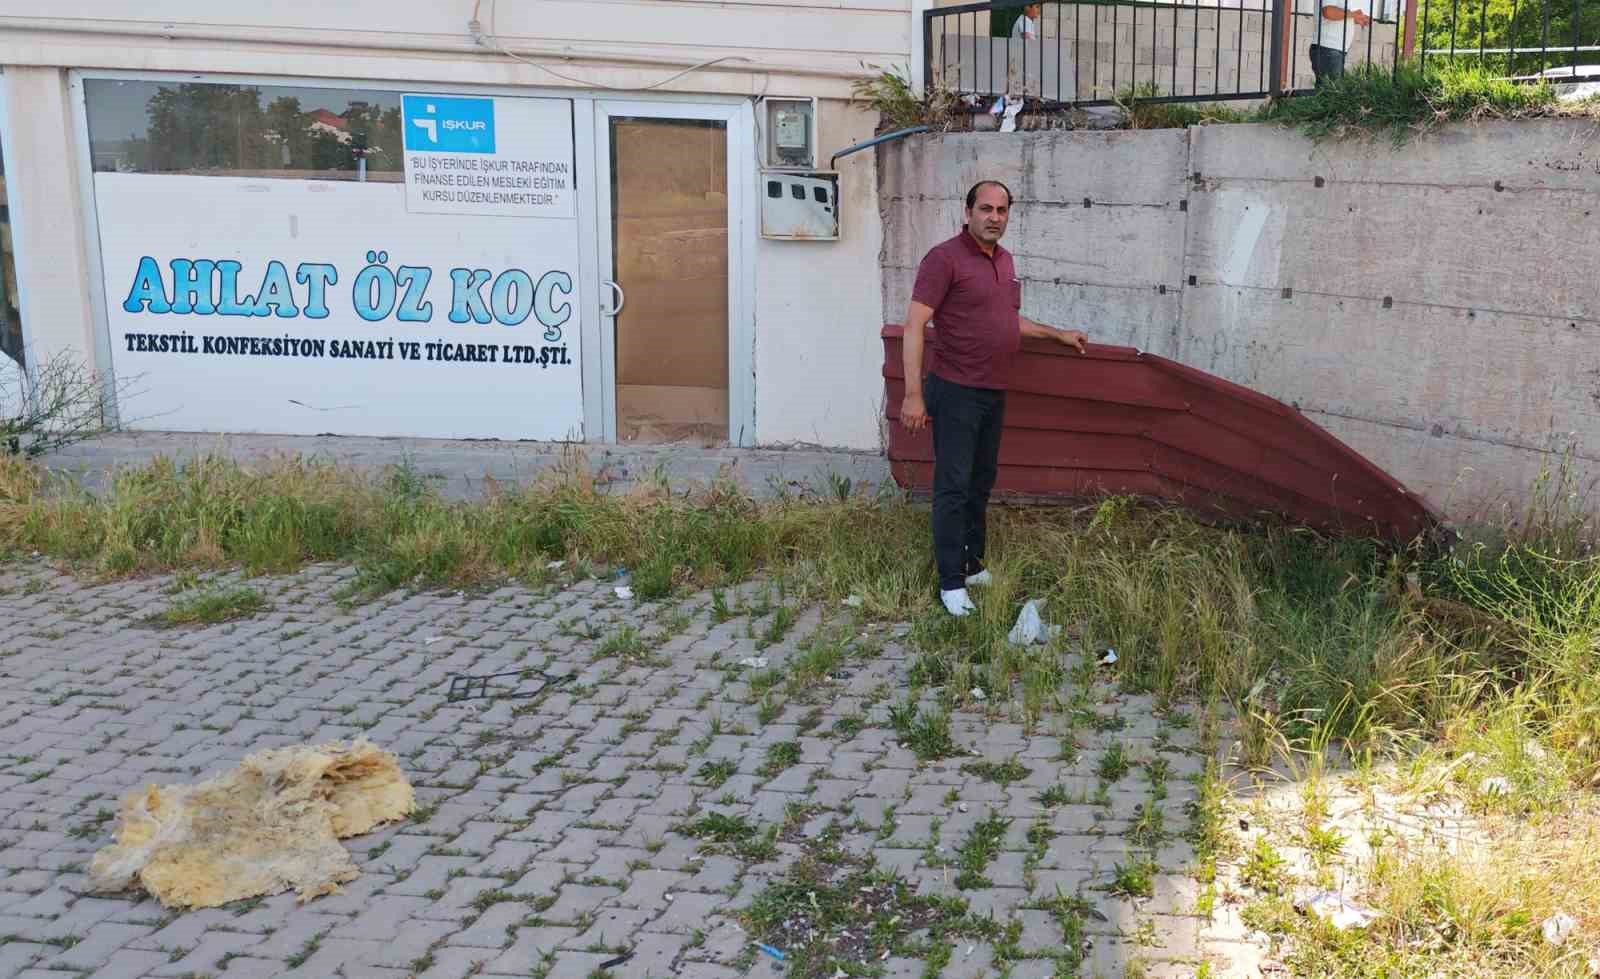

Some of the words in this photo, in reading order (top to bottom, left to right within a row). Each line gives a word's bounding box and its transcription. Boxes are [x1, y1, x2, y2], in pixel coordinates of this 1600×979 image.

[428, 157, 478, 172] İŞYERİNDE
[480, 158, 508, 174] İŞKUR
[511, 160, 568, 174] TARAFINDAN
[422, 190, 454, 202] KURSU
[123, 256, 338, 319] AHLAT
[352, 250, 433, 322] ÖZ
[448, 268, 572, 342] KOÇ
[125, 331, 198, 354] TEKSTİL
[202, 333, 325, 357] KONFEKSİYON
[329, 337, 394, 359] SANAYİ
[398, 342, 421, 361] VE
[425, 339, 499, 363] TİCARET
